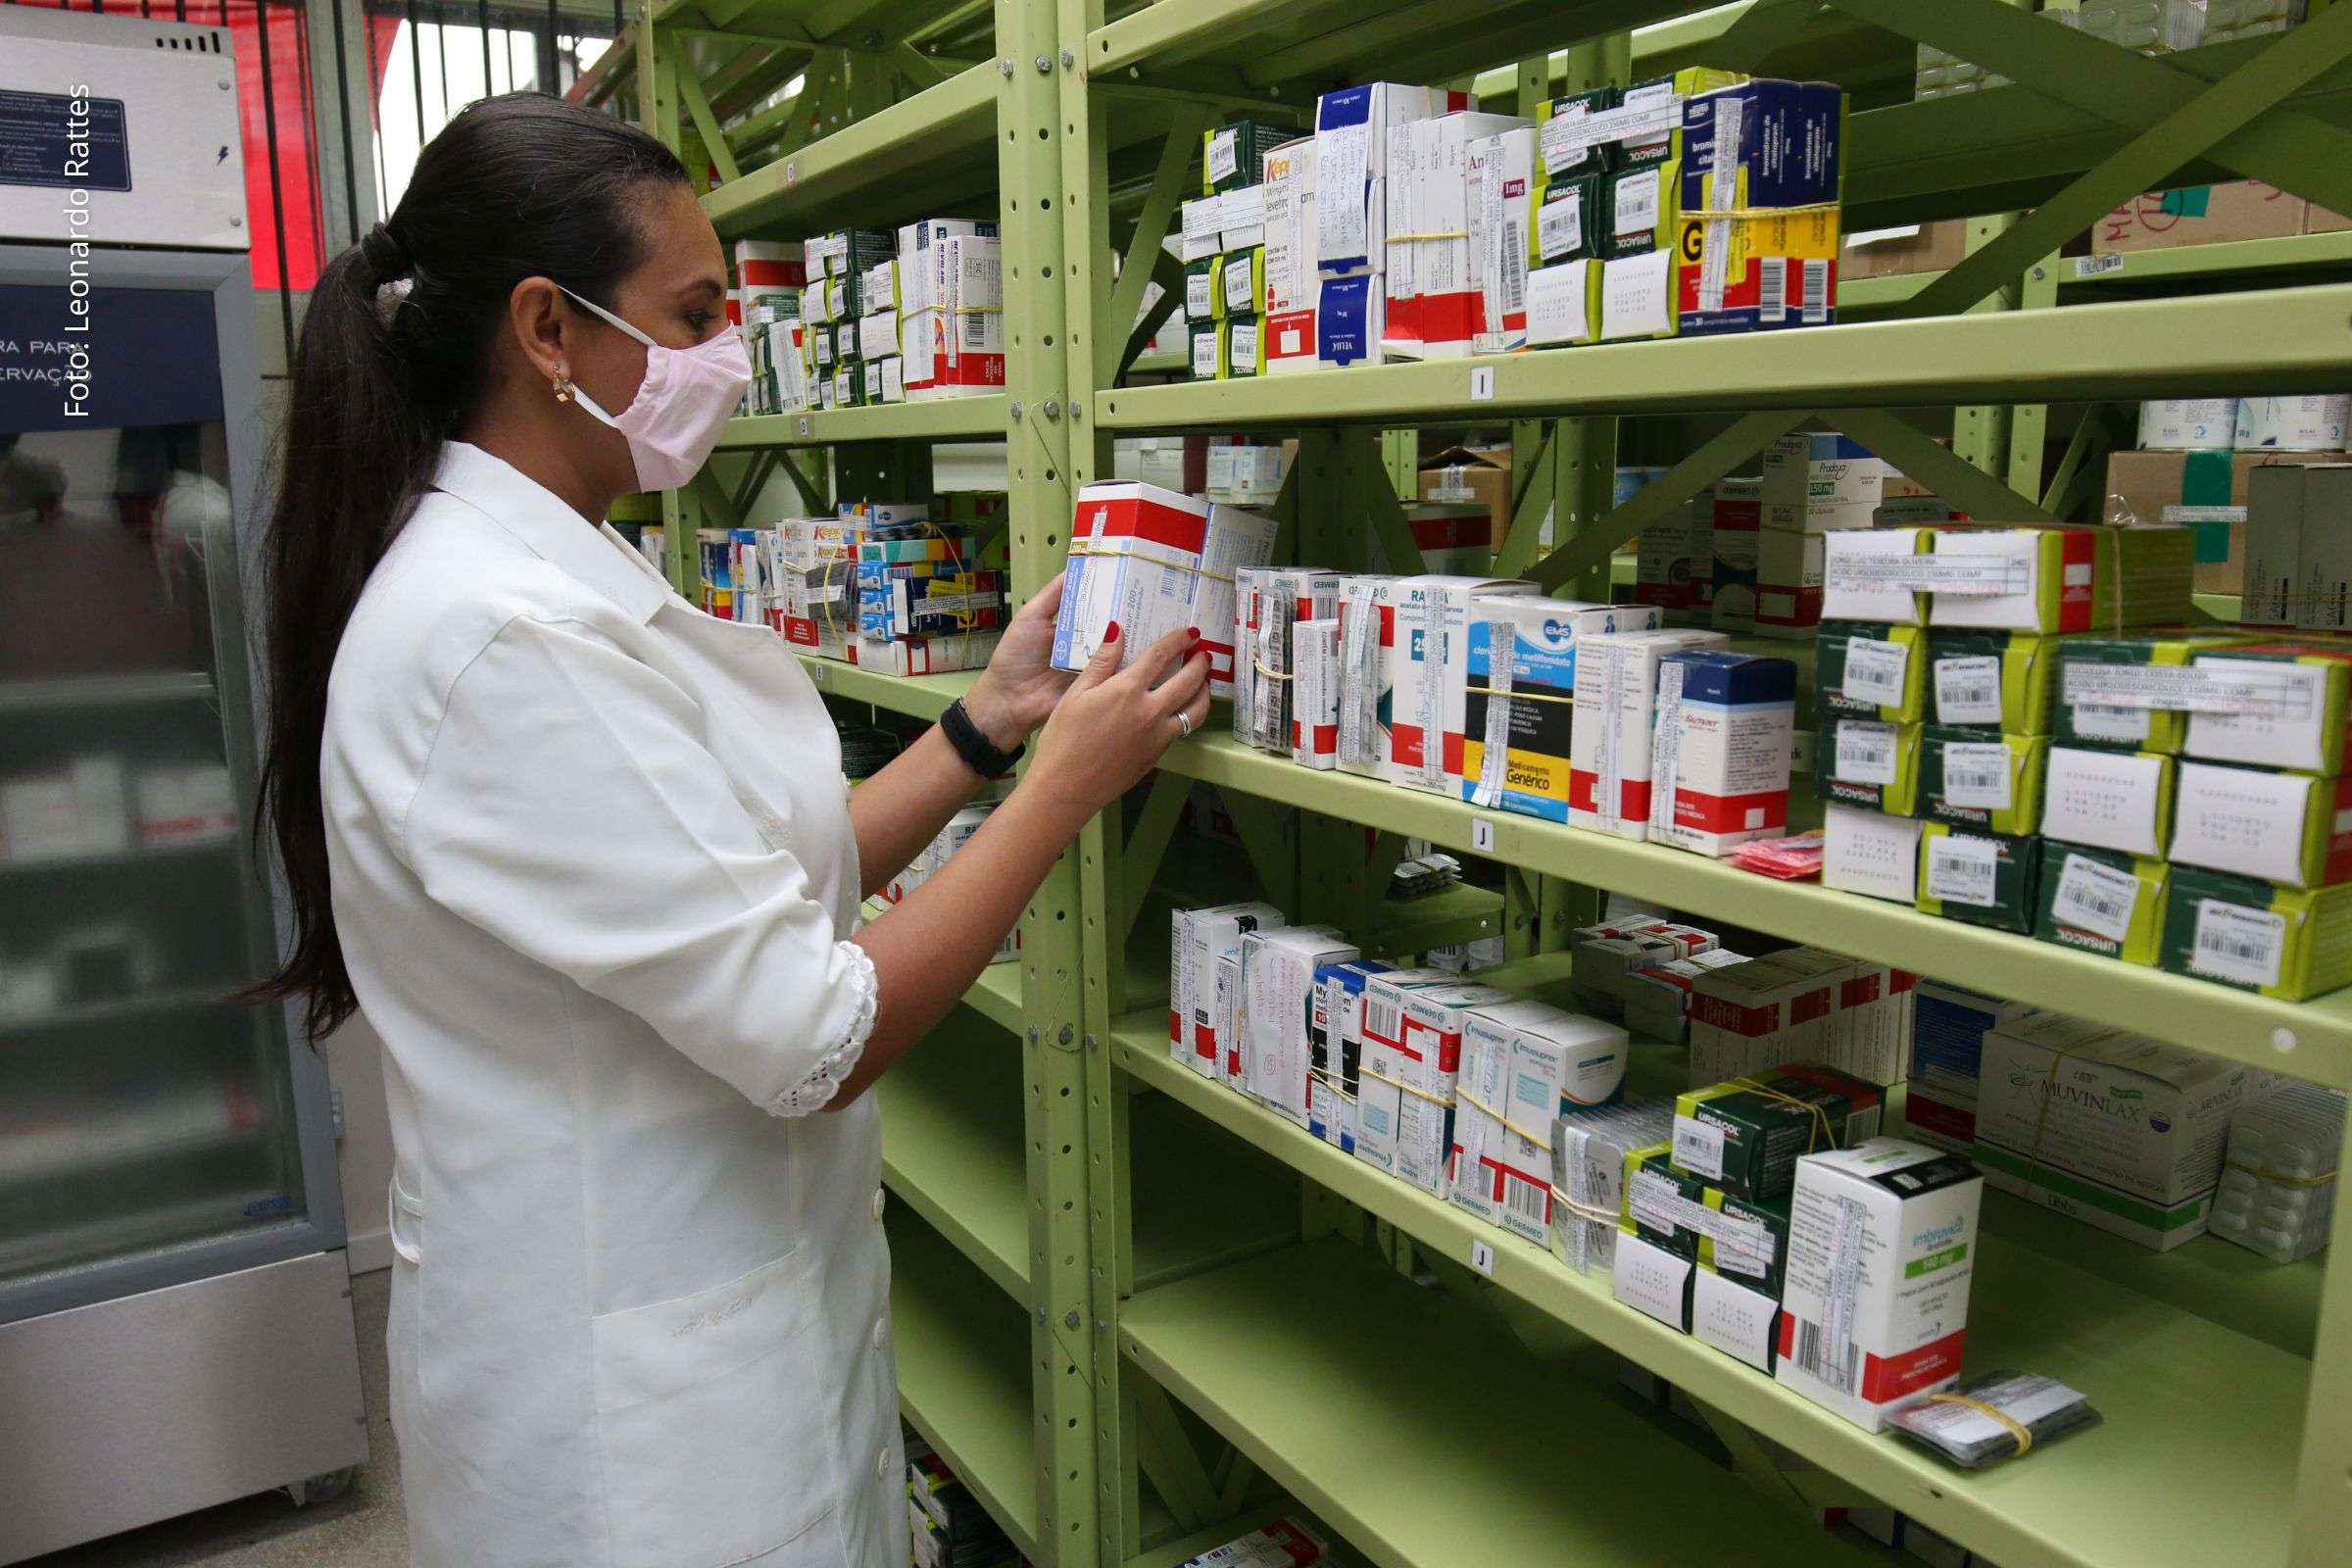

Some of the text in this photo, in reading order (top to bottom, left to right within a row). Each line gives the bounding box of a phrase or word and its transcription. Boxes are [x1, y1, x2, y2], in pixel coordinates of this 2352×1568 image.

[1630, 145, 1669, 163] URSACOL
[1505, 181, 1525, 194] 1mg
[1546, 184, 1582, 199] URSACOL
[1617, 233, 1652, 249] URSACOL
[1683, 220, 1703, 262] G
[29, 341, 84, 354] PARA
[1128, 590, 1137, 609] 200
[1545, 627, 1570, 637] EMS
[1522, 654, 1571, 667] metilfenidato
[1685, 715, 1719, 727] SUTENT
[1508, 760, 1549, 776] Medicamento
[1506, 769, 1549, 790] Genérico
[1832, 787, 1879, 804] URSACOL
[1935, 803, 1986, 823] URSACOL
[1479, 828, 1486, 846] J
[2058, 929, 2117, 954] URSACOL
[1410, 1004, 1438, 1019] GERMED
[2039, 1079, 2141, 1123] MUVINLAX
[1698, 1112, 1739, 1135] URSACOL
[1461, 1196, 1491, 1216] GERMED
[1512, 1218, 1543, 1240] GERMED
[1913, 1218, 1964, 1246] imbruvica
[1479, 1250, 1485, 1266] J
